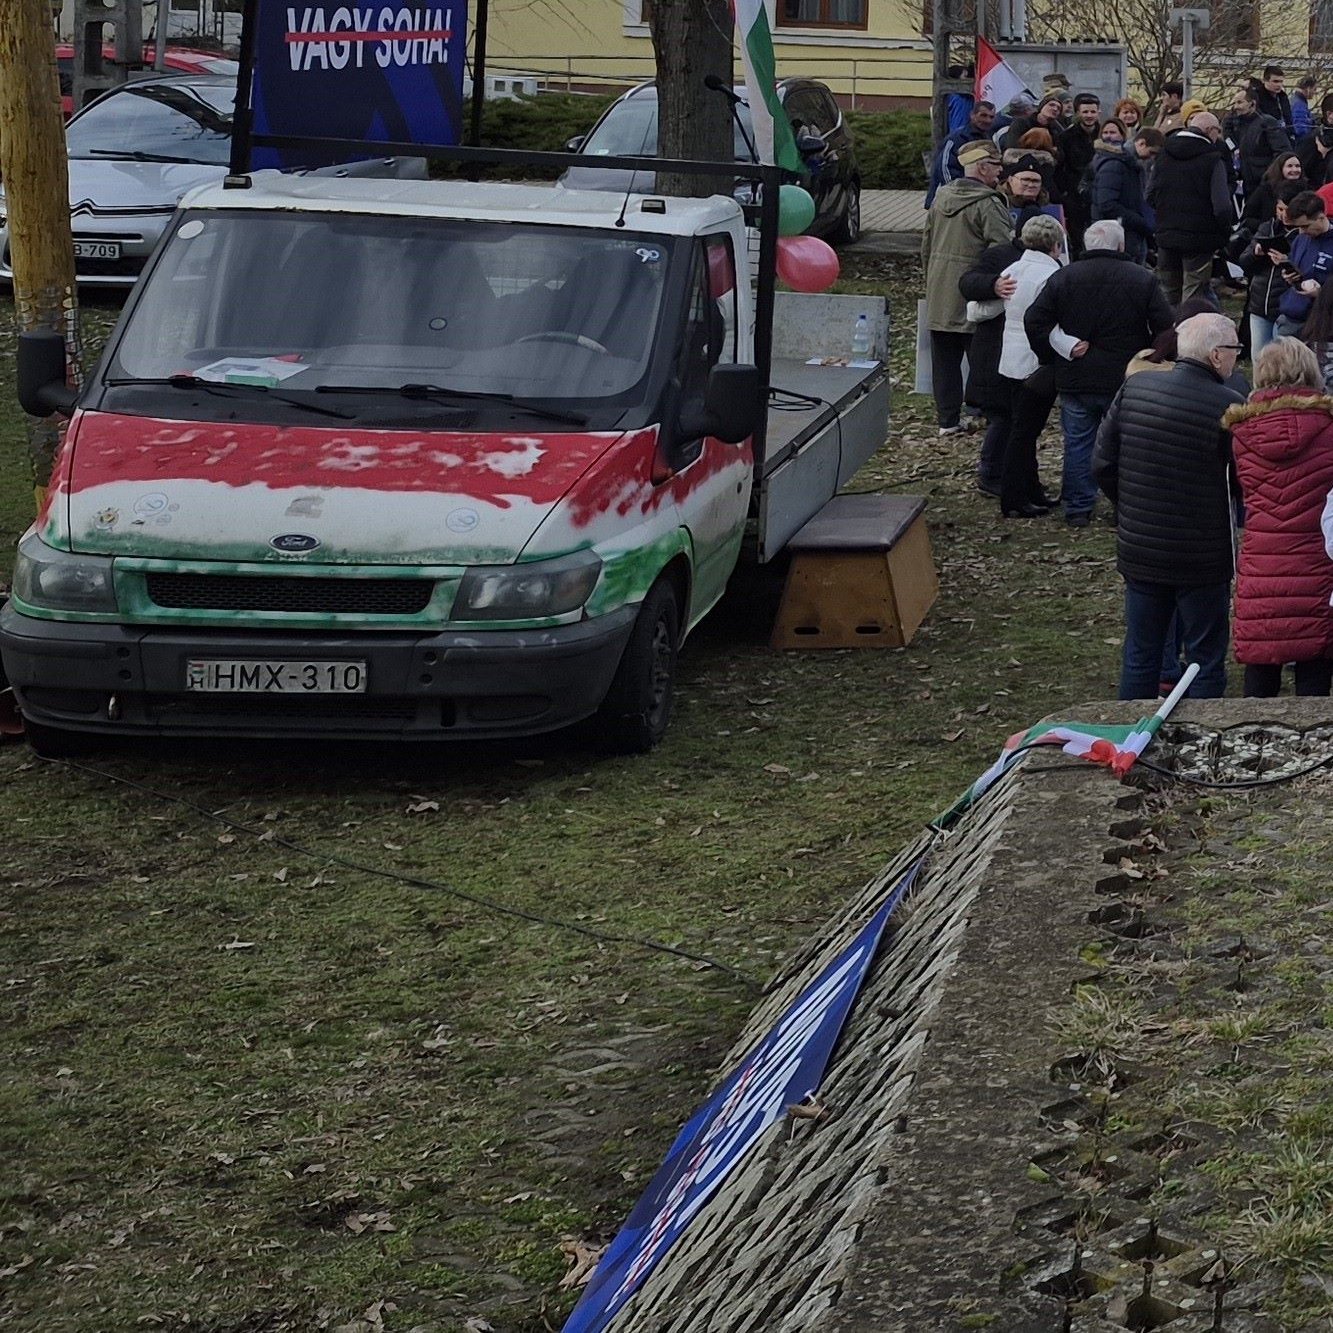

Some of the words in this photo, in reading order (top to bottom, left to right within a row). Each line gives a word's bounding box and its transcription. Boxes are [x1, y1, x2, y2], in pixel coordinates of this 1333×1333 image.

[287, 7, 373, 71] VAGY
[374, 7, 452, 68] SOHA!
[281, 535, 308, 546] Ford
[214, 664, 361, 691] HMX-310
